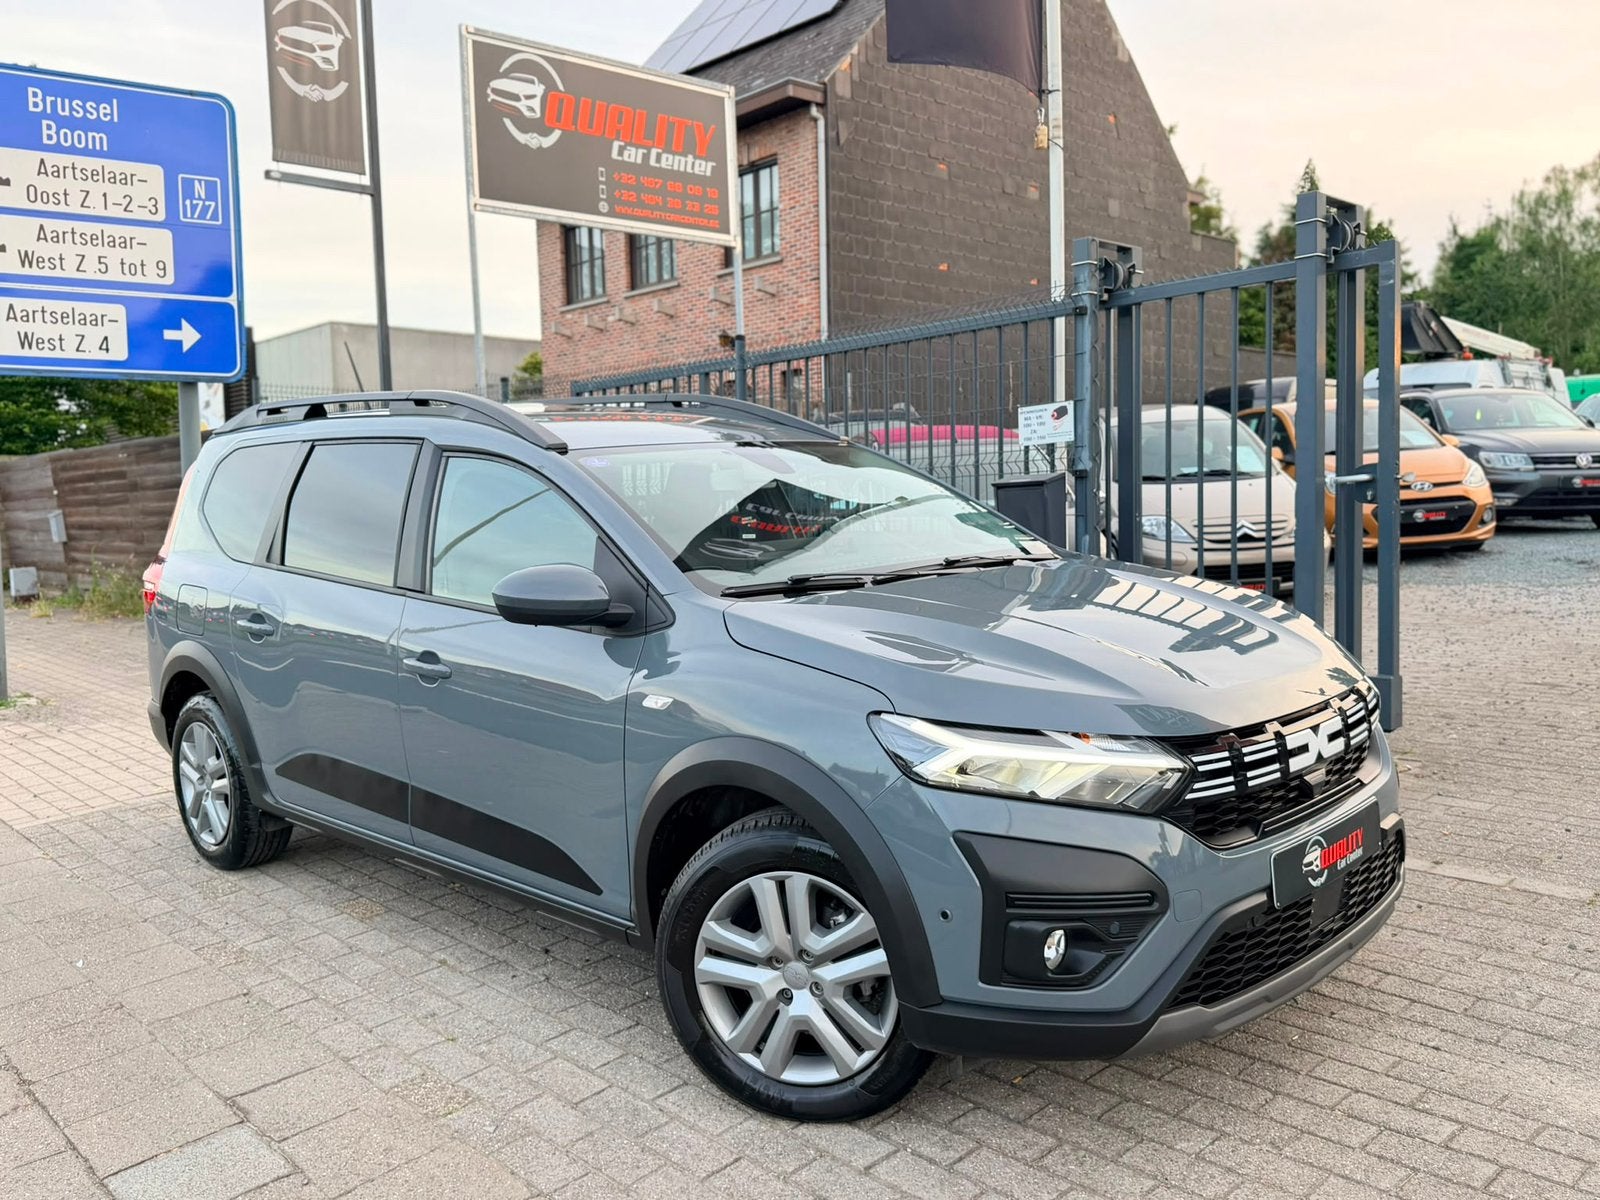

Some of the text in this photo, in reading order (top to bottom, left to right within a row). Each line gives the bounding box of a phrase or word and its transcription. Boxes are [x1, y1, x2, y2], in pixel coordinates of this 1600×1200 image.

[27, 86, 119, 123] Brussel
[41, 119, 108, 151] Boom
[544, 91, 717, 158] QUALITY
[37, 158, 148, 187] Aartselaar-
[611, 140, 717, 177] Car Center
[26, 184, 70, 207] Oost
[194, 180, 206, 200] N
[184, 199, 216, 221] 177
[36, 223, 147, 250] Aartselaar-
[18, 249, 65, 272] West
[120, 257, 147, 278] tot
[156, 260, 167, 279] 9
[5, 303, 119, 328] Aartselaar-
[17, 330, 65, 352] West
[1321, 826, 1363, 869] QUALITY
